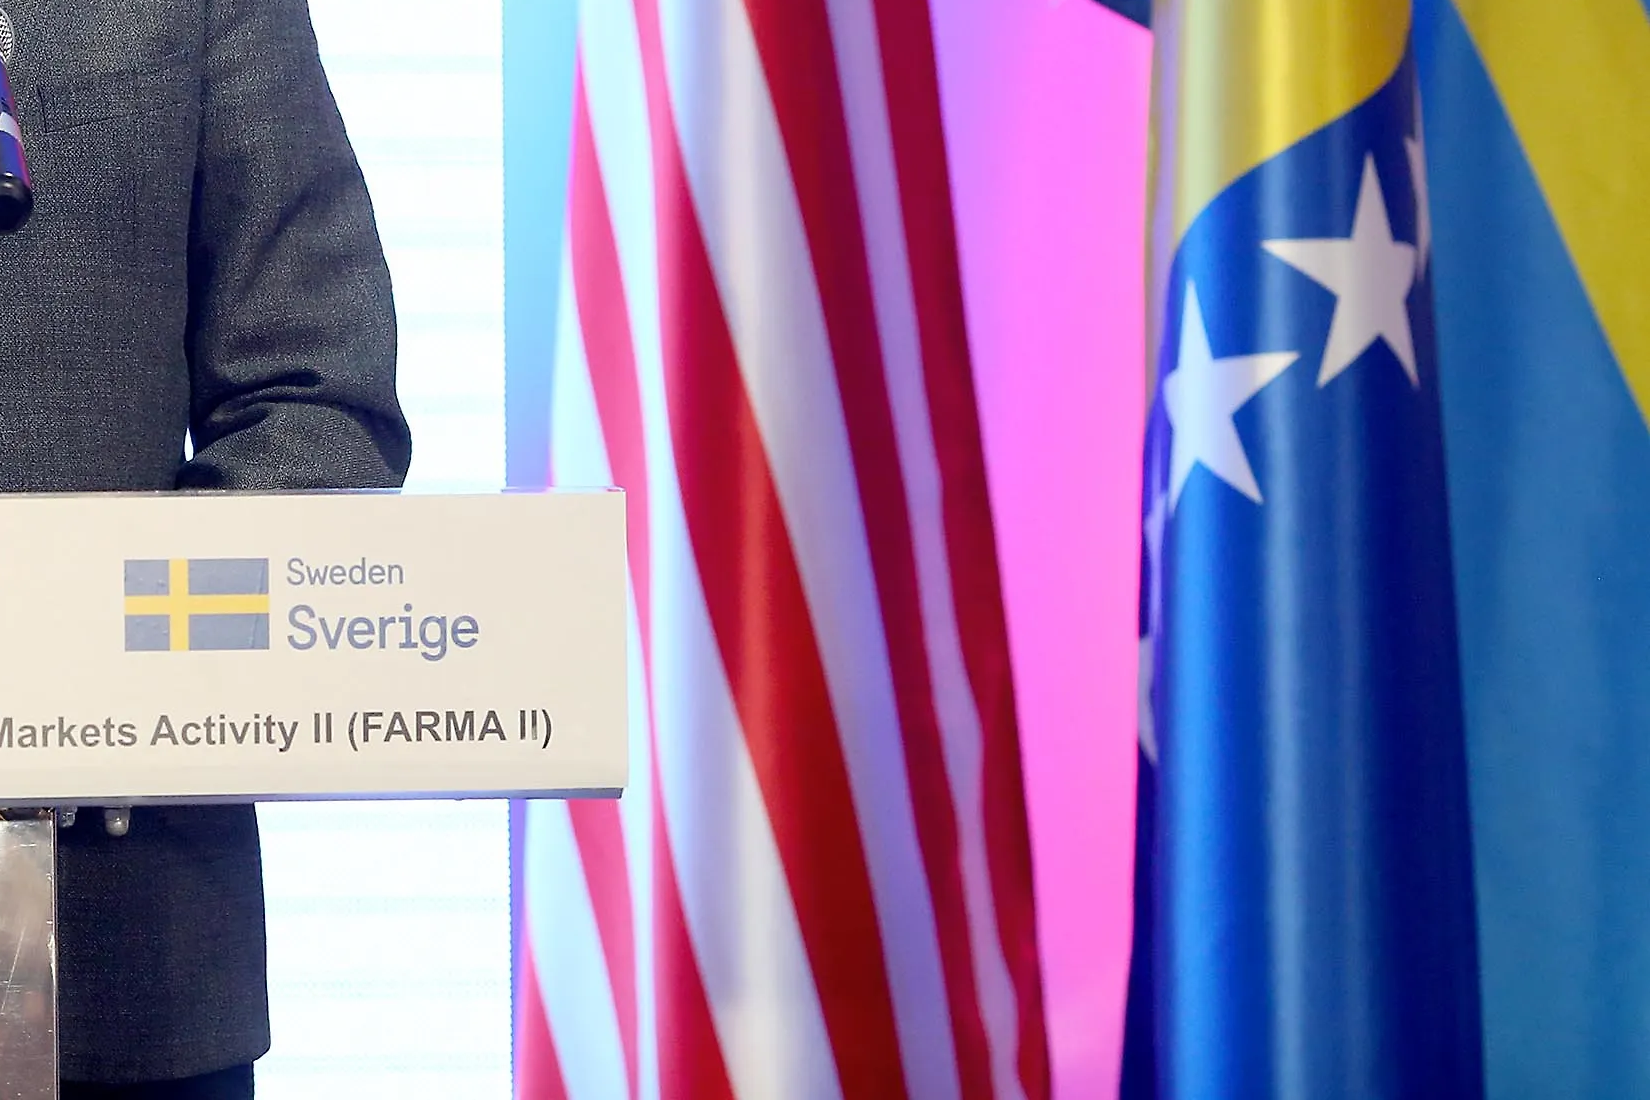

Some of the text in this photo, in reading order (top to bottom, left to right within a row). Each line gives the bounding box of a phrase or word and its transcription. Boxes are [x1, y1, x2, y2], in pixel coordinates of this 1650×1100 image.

[286, 557, 404, 586] Sweden
[286, 603, 480, 662] Sverige
[150, 712, 299, 752] Activity
[314, 712, 333, 744] II
[348, 709, 508, 752] (FARMA
[518, 708, 553, 750] II)
